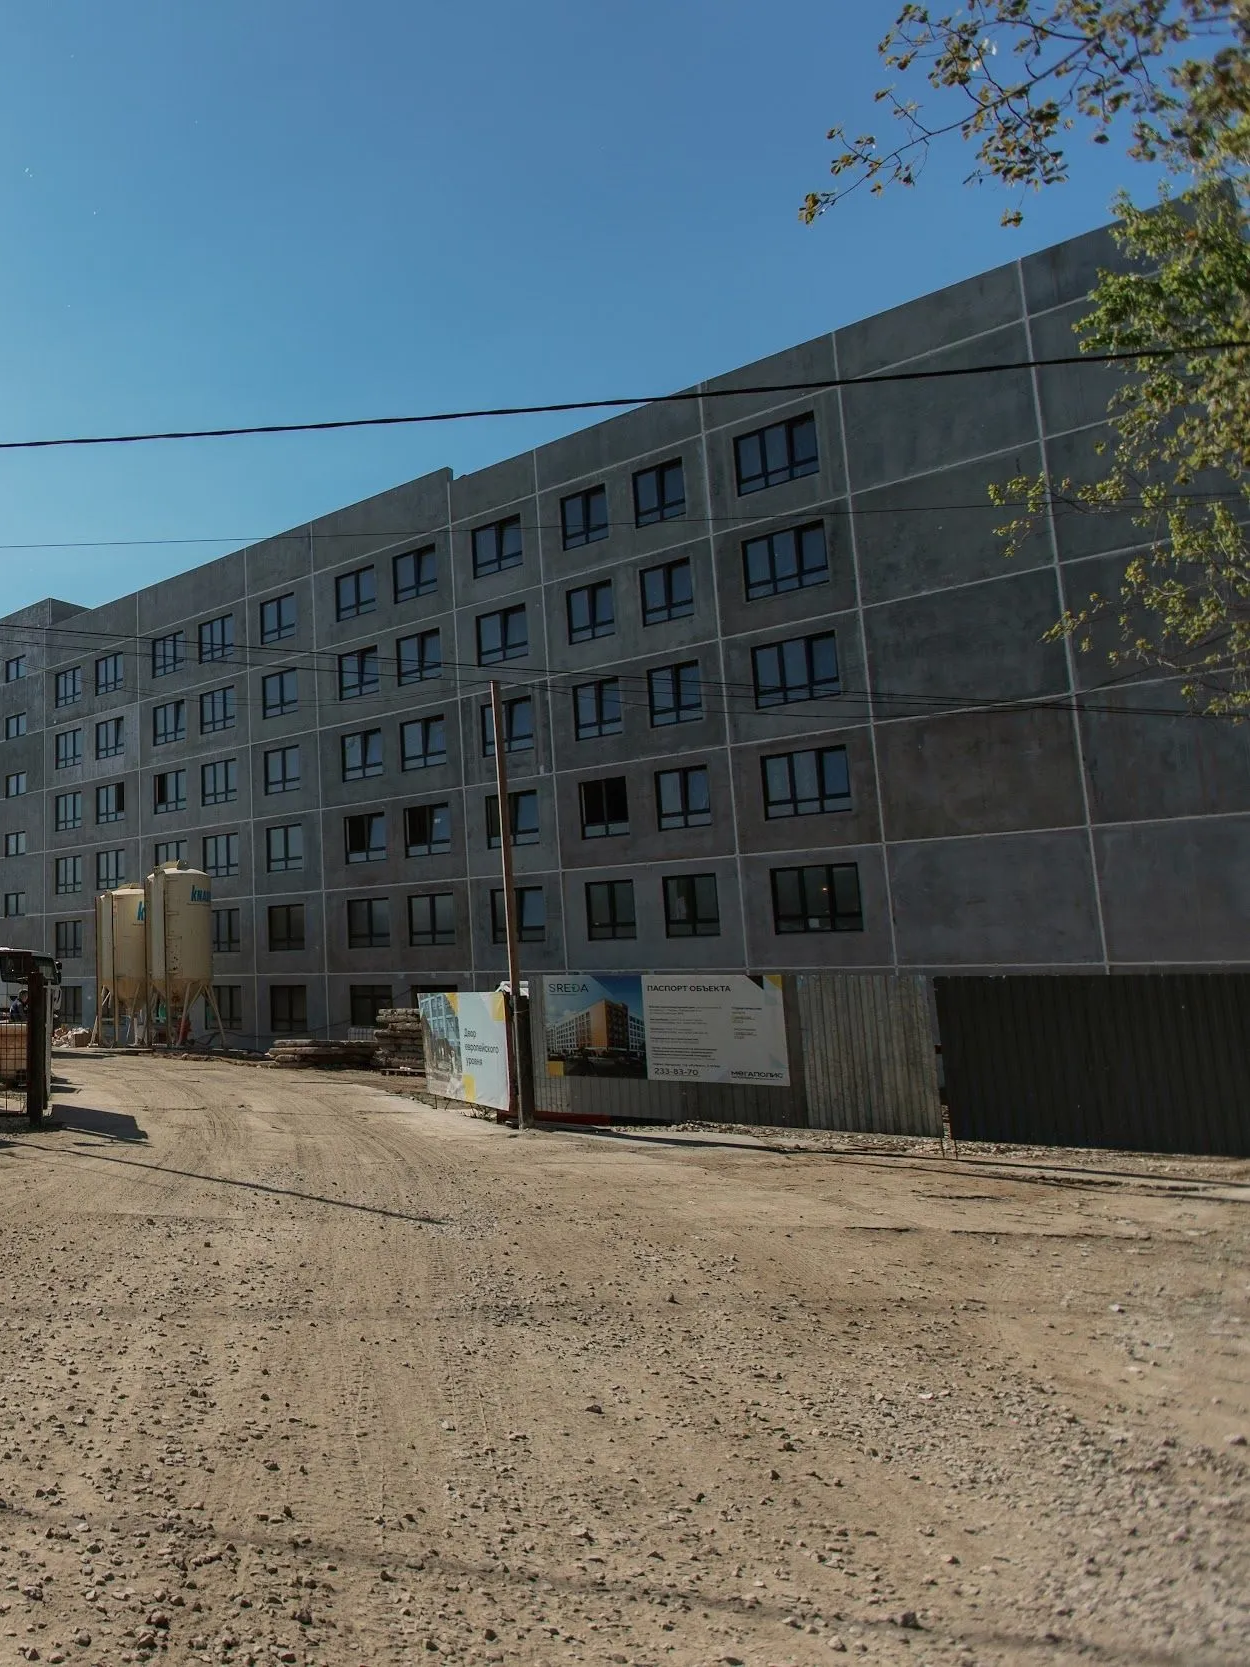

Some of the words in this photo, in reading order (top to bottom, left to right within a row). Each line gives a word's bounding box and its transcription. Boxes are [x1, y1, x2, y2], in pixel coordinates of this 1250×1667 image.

[548, 983, 589, 993] SREDA
[689, 985, 731, 993] ОБЪЕКТА
[654, 1067, 699, 1076] 233-83-70
